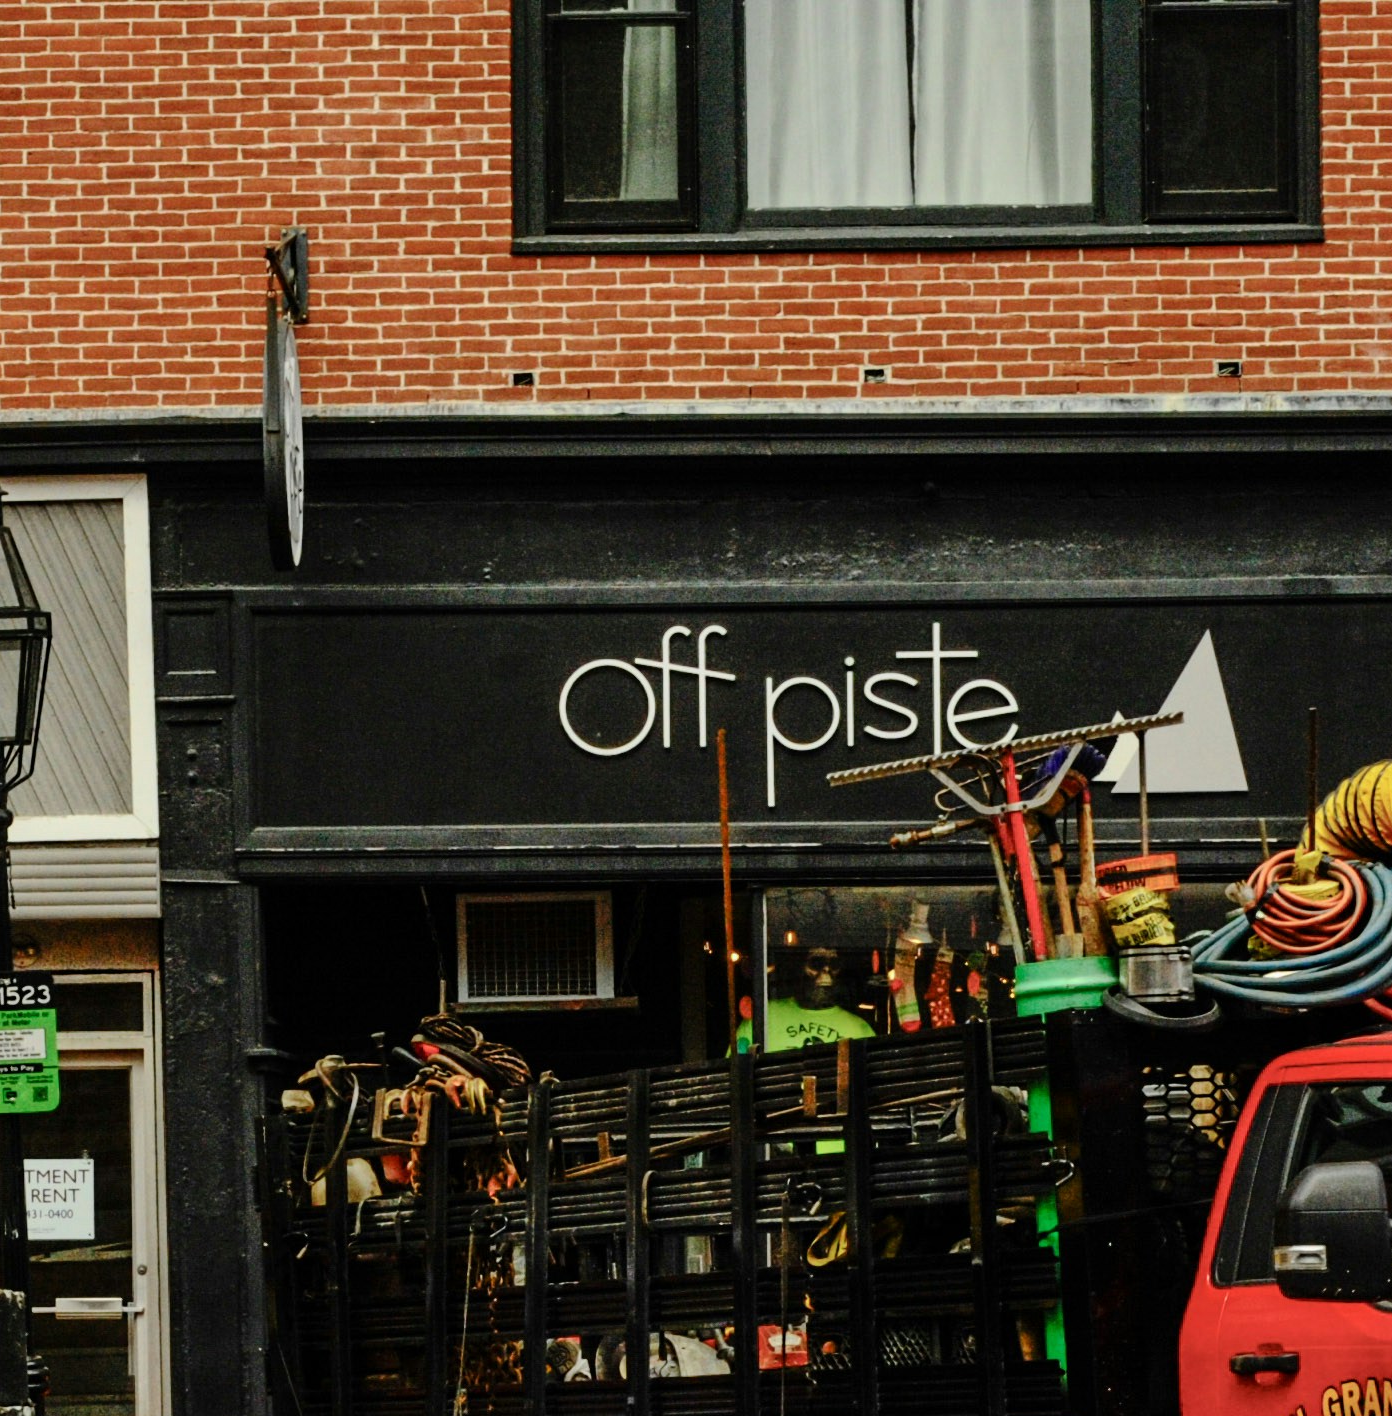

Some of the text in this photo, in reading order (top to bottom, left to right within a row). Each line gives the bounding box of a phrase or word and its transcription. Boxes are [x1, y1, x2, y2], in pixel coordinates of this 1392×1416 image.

[765, 621, 1020, 808] piste
[20, 1064, 35, 1073] Pay
[31, 1188, 80, 1203] RENT
